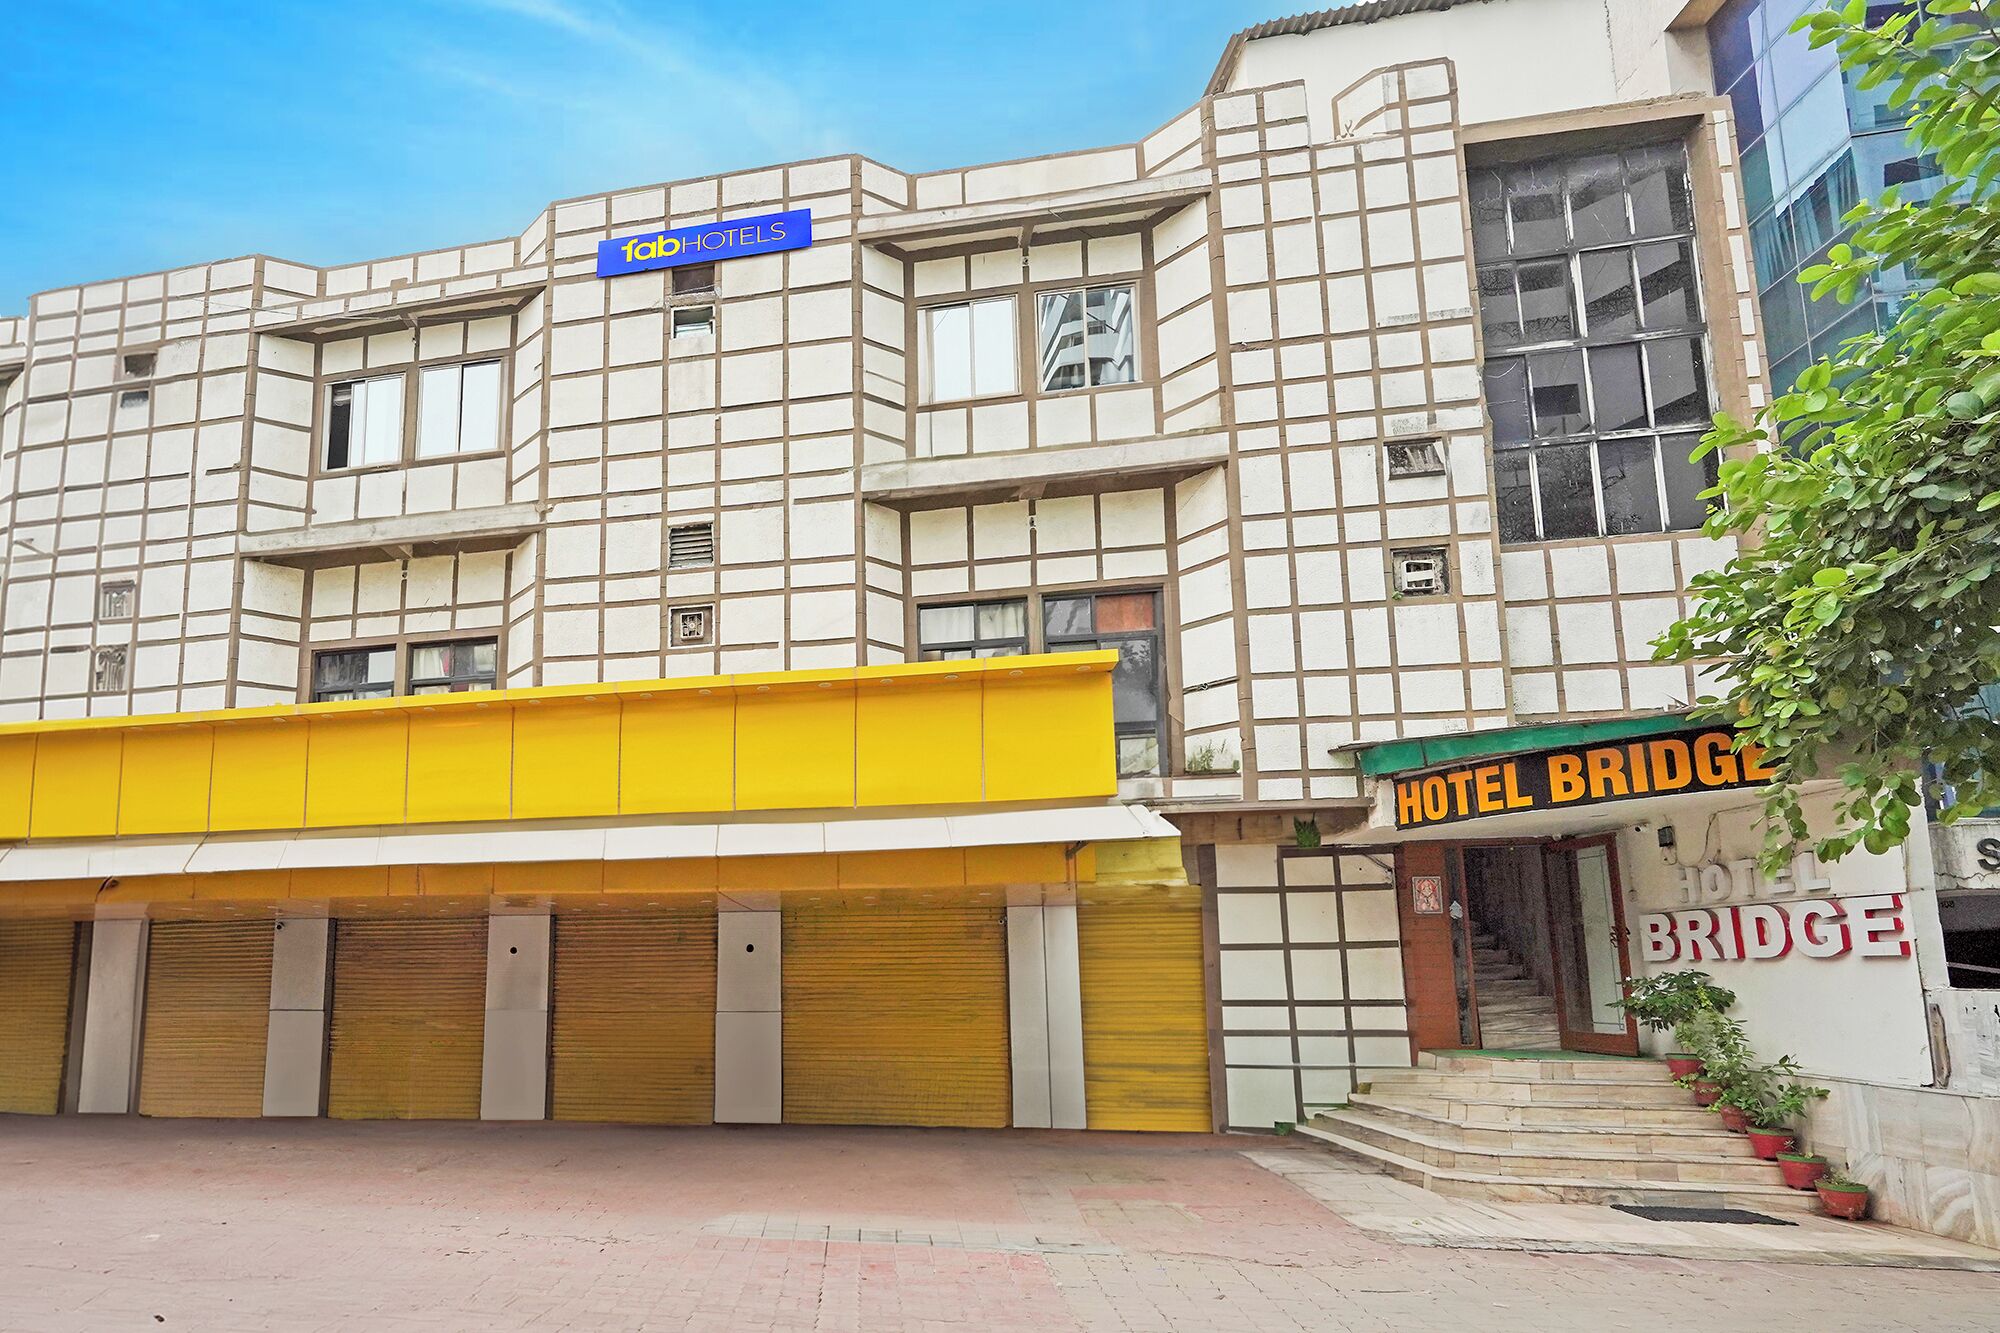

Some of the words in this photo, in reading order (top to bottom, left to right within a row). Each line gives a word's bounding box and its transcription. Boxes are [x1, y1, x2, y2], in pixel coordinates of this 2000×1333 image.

[621, 222, 787, 263] fabHOTELS
[1397, 762, 1534, 825] HOTEL
[1547, 732, 1777, 803] BRIDGE
[1677, 851, 1831, 904] HOTEL
[1640, 894, 1911, 962] BRIDGE
